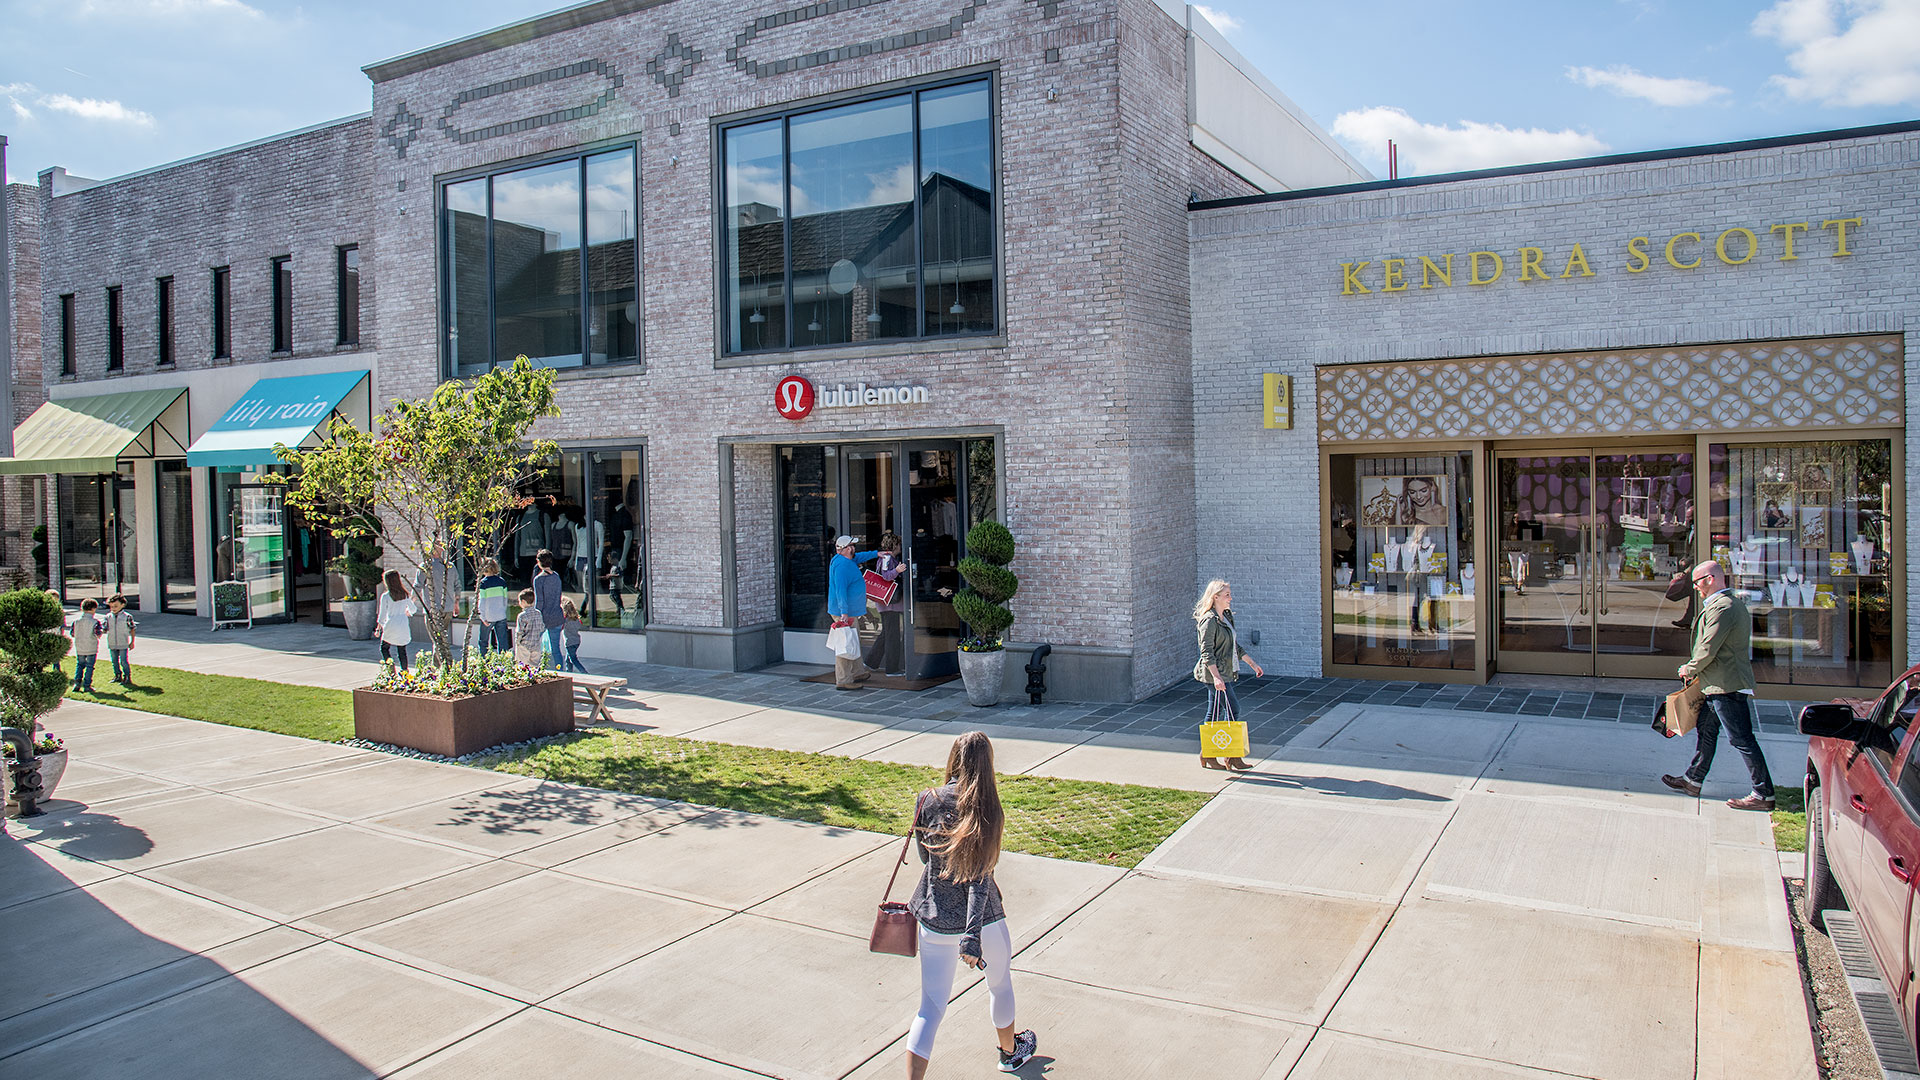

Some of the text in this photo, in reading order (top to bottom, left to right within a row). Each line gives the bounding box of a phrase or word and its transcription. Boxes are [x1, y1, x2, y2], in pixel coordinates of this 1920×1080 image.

[1340, 217, 1862, 295] KENDRA SCOTT
[225, 395, 328, 427] lily rain
[819, 383, 929, 408] lululemon
